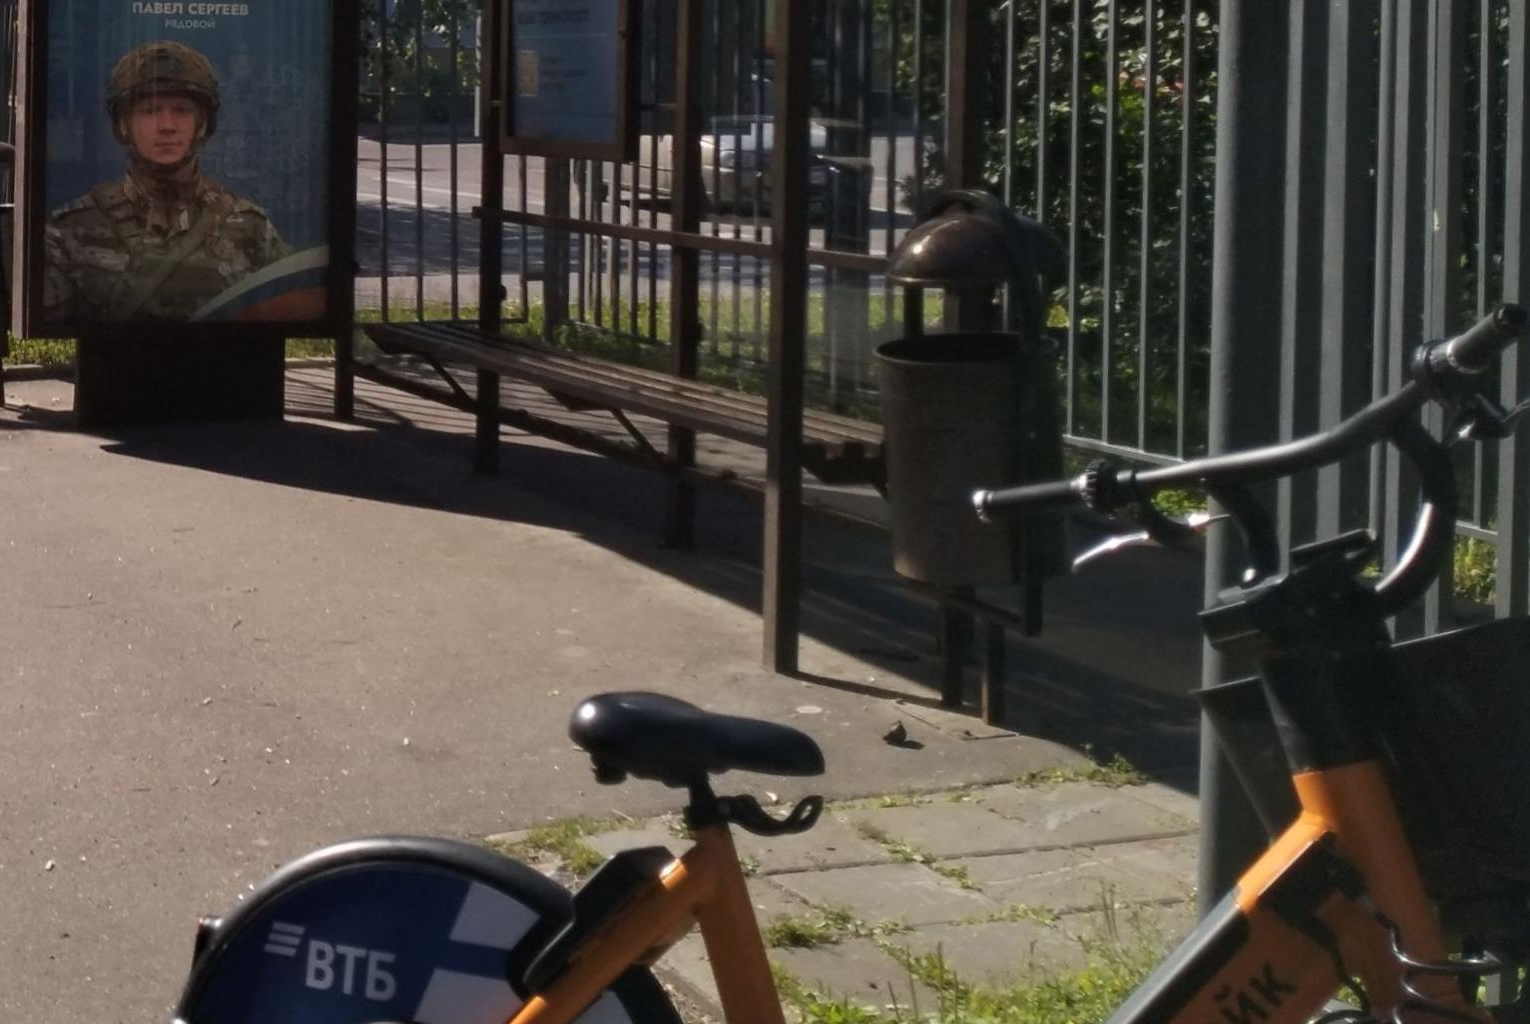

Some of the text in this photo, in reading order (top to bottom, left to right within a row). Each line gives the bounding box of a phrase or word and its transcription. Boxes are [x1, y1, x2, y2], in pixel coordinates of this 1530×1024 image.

[133, 2, 250, 16] ПАВЕЛ СЕРГЕЕВ
[165, 18, 216, 29] РЯДОВОЙ
[305, 940, 397, 1002] ВТБ
